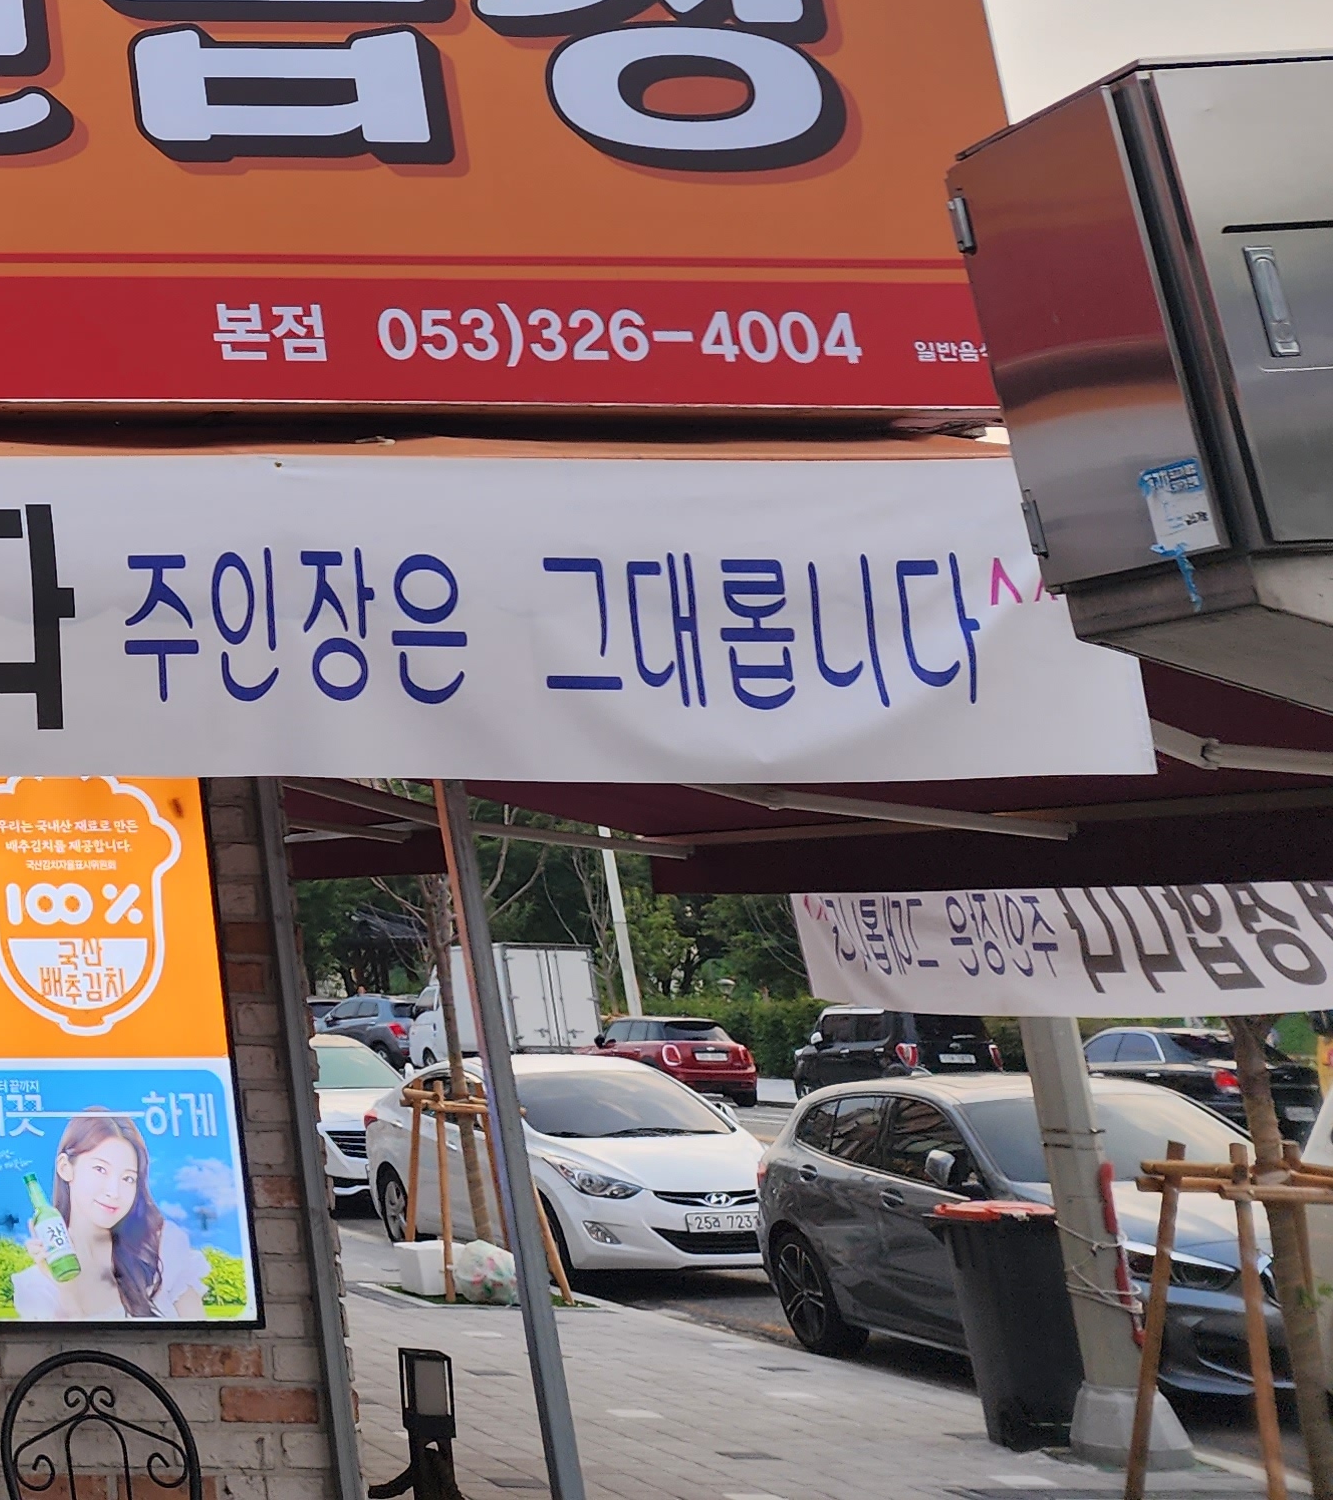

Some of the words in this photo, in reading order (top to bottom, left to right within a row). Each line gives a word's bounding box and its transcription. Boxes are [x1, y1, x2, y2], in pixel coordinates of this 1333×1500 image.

[212, 300, 328, 364] 본점
[375, 307, 864, 370] 053)326-4004
[123, 546, 470, 706] 주인장은
[35, 819, 73, 834] 국내산
[74, 819, 113, 833] 재료로
[113, 819, 140, 834] 만든
[5, 839, 67, 854] 배추김치를
[68, 838, 133, 853] 제공합니다.
[58, 938, 104, 971] 국산
[38, 966, 127, 1006] 배추김치
[9, 1079, 40, 1093] 끝까지
[726, 1214, 759, 1230] 723
